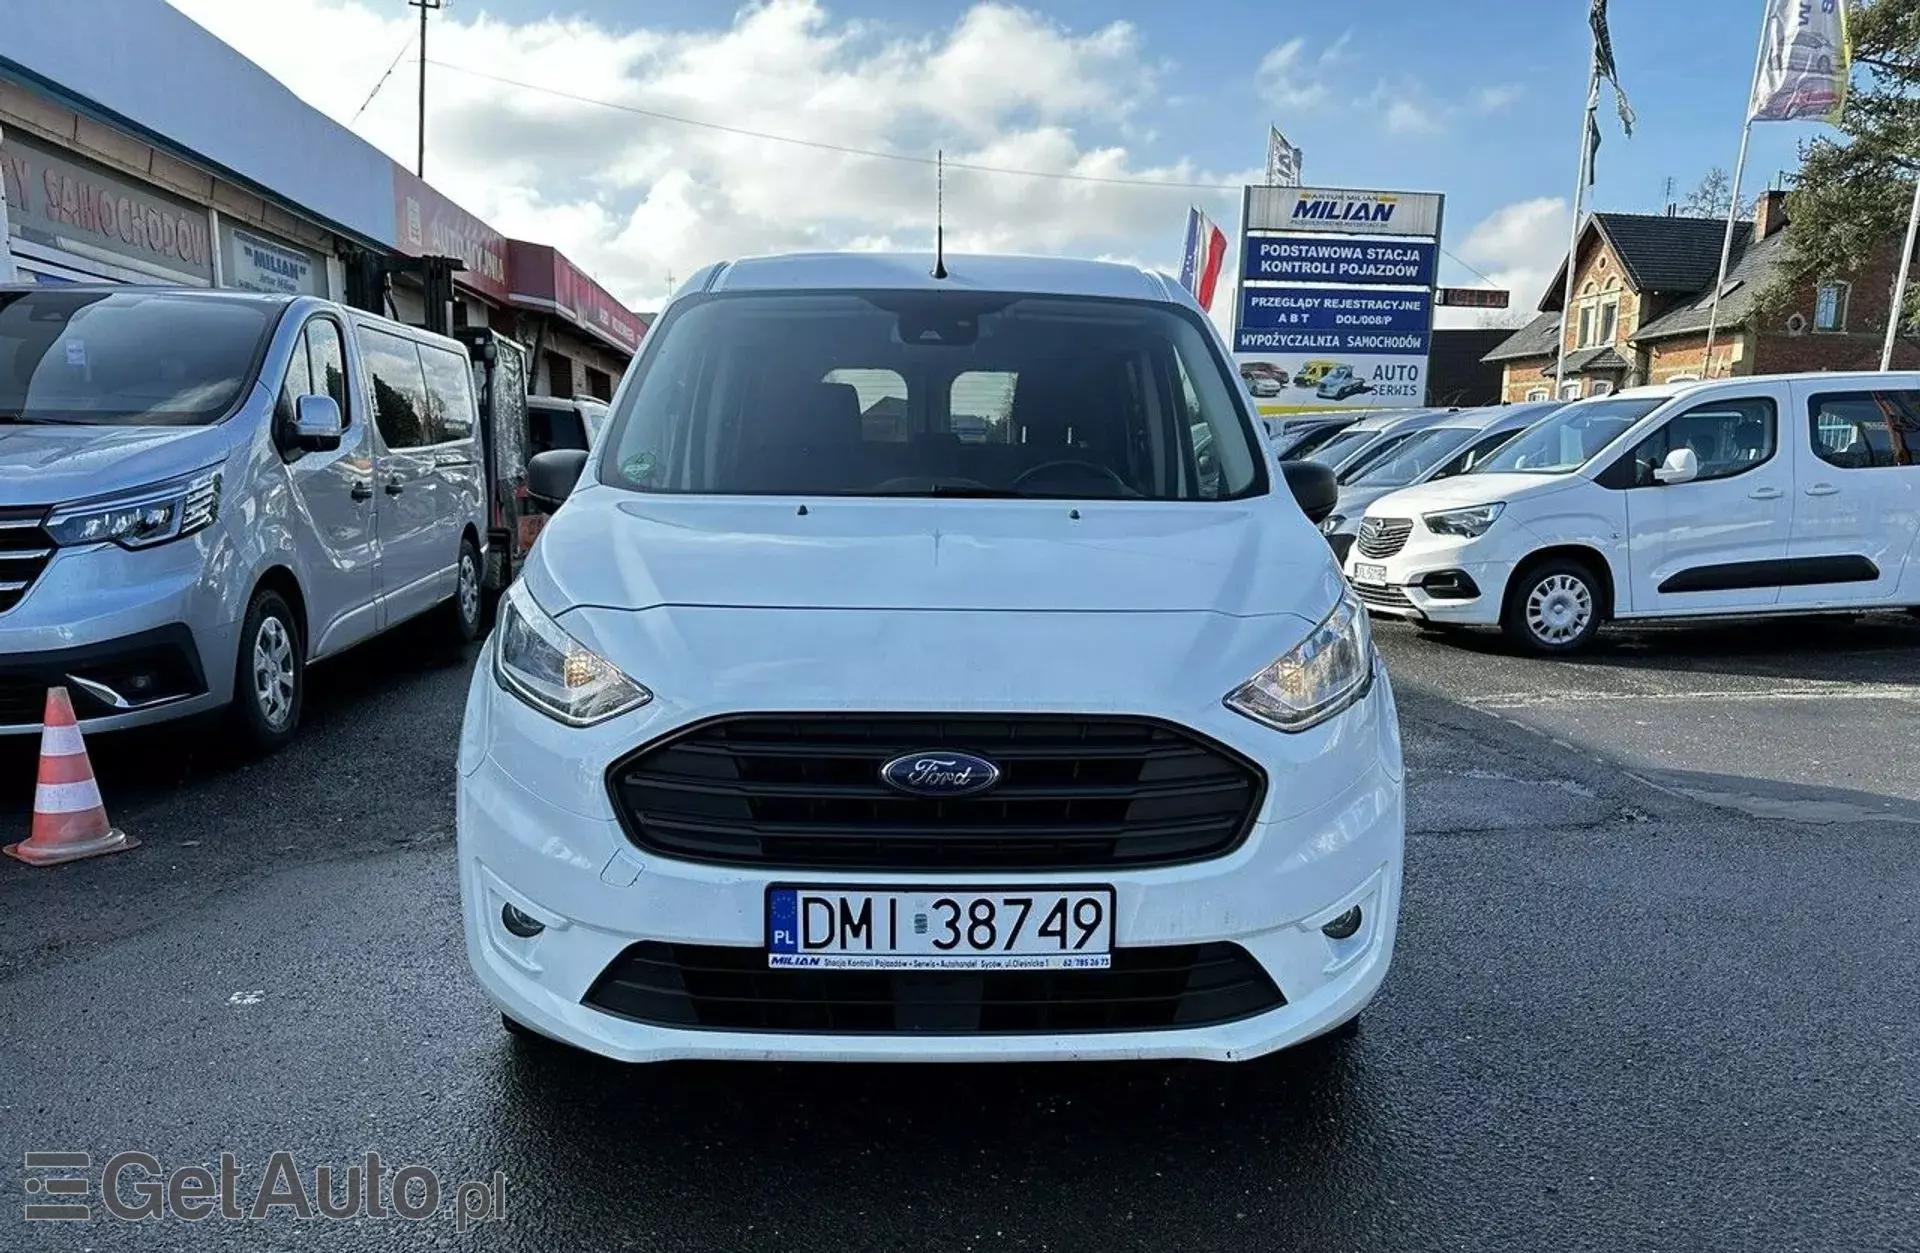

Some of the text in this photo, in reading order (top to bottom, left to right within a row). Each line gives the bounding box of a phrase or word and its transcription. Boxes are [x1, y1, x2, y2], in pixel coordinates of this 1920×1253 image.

[1292, 199, 1395, 221] MILIAN
[1260, 244, 1420, 262] PODSTAWOWA STACJA
[1261, 260, 1419, 277] KONTROLI POJAZDÓW
[1251, 297, 1421, 311] PRZEGLĄDY REJESTRACYJNE
[1241, 331, 1421, 349] WYPOŻYCZALNIA SAMOCHODÓW
[1372, 364, 1419, 381] AUTO
[1371, 384, 1418, 396] SERWIS
[908, 759, 971, 785] Ford
[774, 897, 1103, 951] PL DMI 38749
[770, 956, 821, 966] MILIAN
